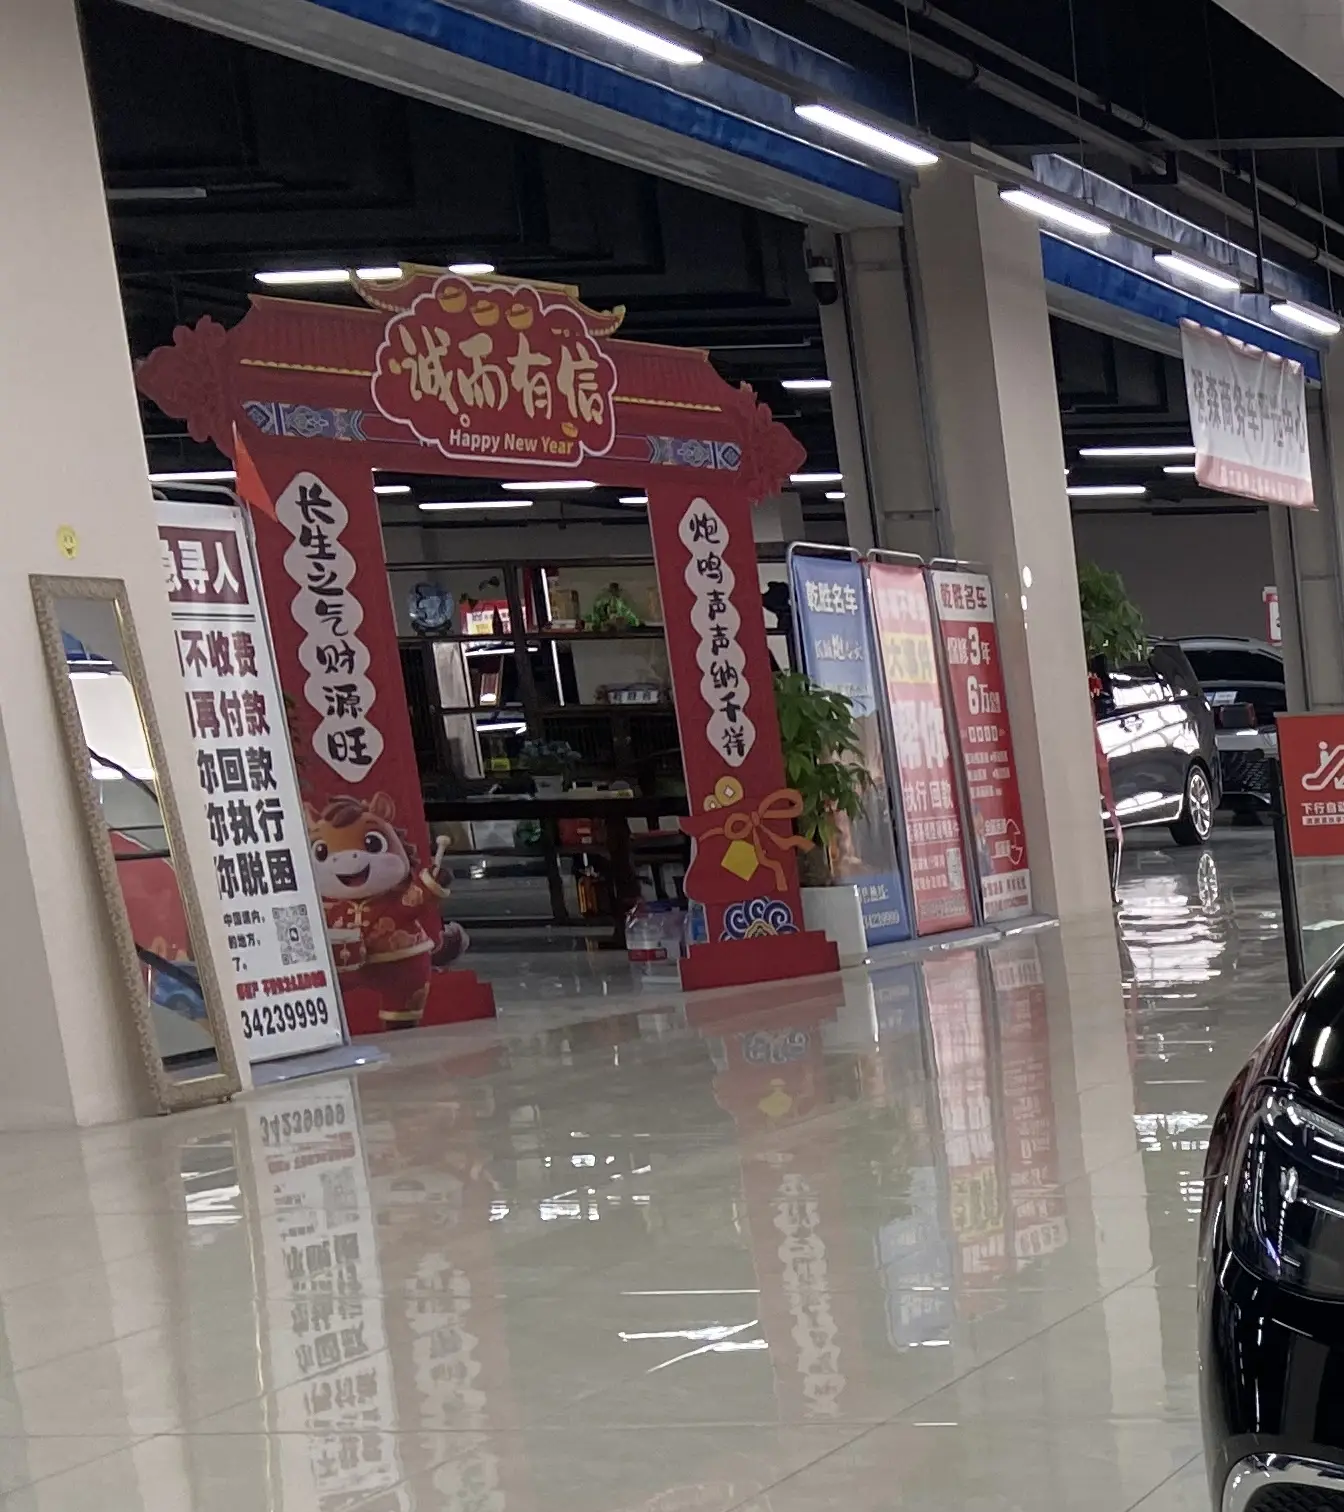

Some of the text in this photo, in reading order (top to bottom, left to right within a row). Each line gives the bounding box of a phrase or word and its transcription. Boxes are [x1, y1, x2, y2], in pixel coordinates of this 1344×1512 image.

[450, 428, 574, 455] Happy New Year
[174, 629, 259, 679] 不收费
[689, 512, 746, 758] 炮鸣声声纳千祥
[185, 689, 271, 740] 再付款
[241, 996, 329, 1039] 34239999
